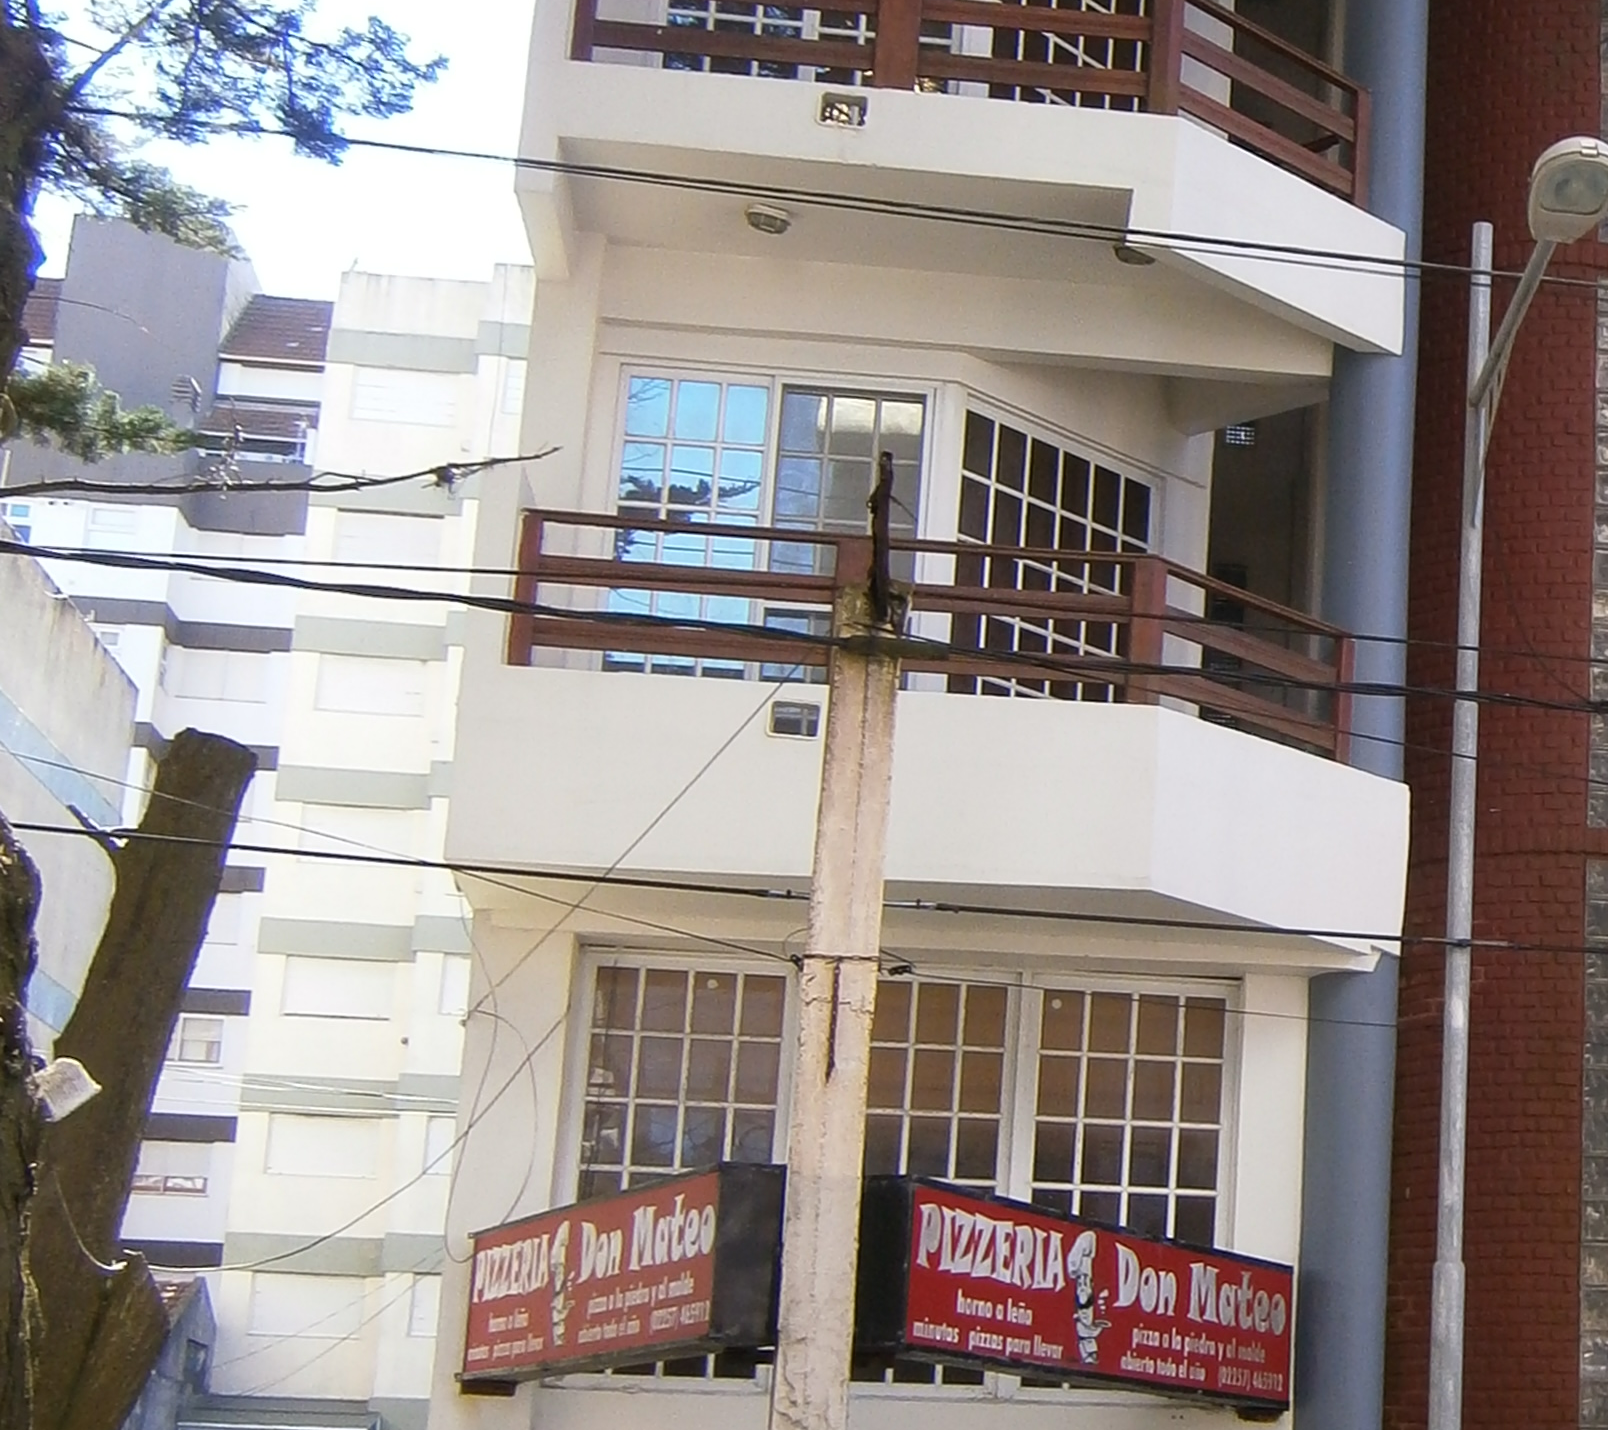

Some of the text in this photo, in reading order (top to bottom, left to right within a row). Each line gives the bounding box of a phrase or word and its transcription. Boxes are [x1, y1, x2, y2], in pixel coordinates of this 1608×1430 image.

[472, 1193, 716, 1303] PIZZERIA Don Mateo
[916, 1203, 1286, 1335] PIZZERIA Don Mateo
[957, 1288, 1033, 1325] horno a leña
[913, 1317, 1064, 1359] minutas pizzas para llevar
[1132, 1323, 1160, 1349] pizza
[1162, 1332, 1169, 1349] a
[1171, 1327, 1182, 1351] la
[1184, 1332, 1216, 1357] piedra
[1217, 1341, 1224, 1361] y
[1120, 1351, 1155, 1374] abierto
[1156, 1357, 1177, 1377] todo
[1178, 1359, 1188, 1379] el
